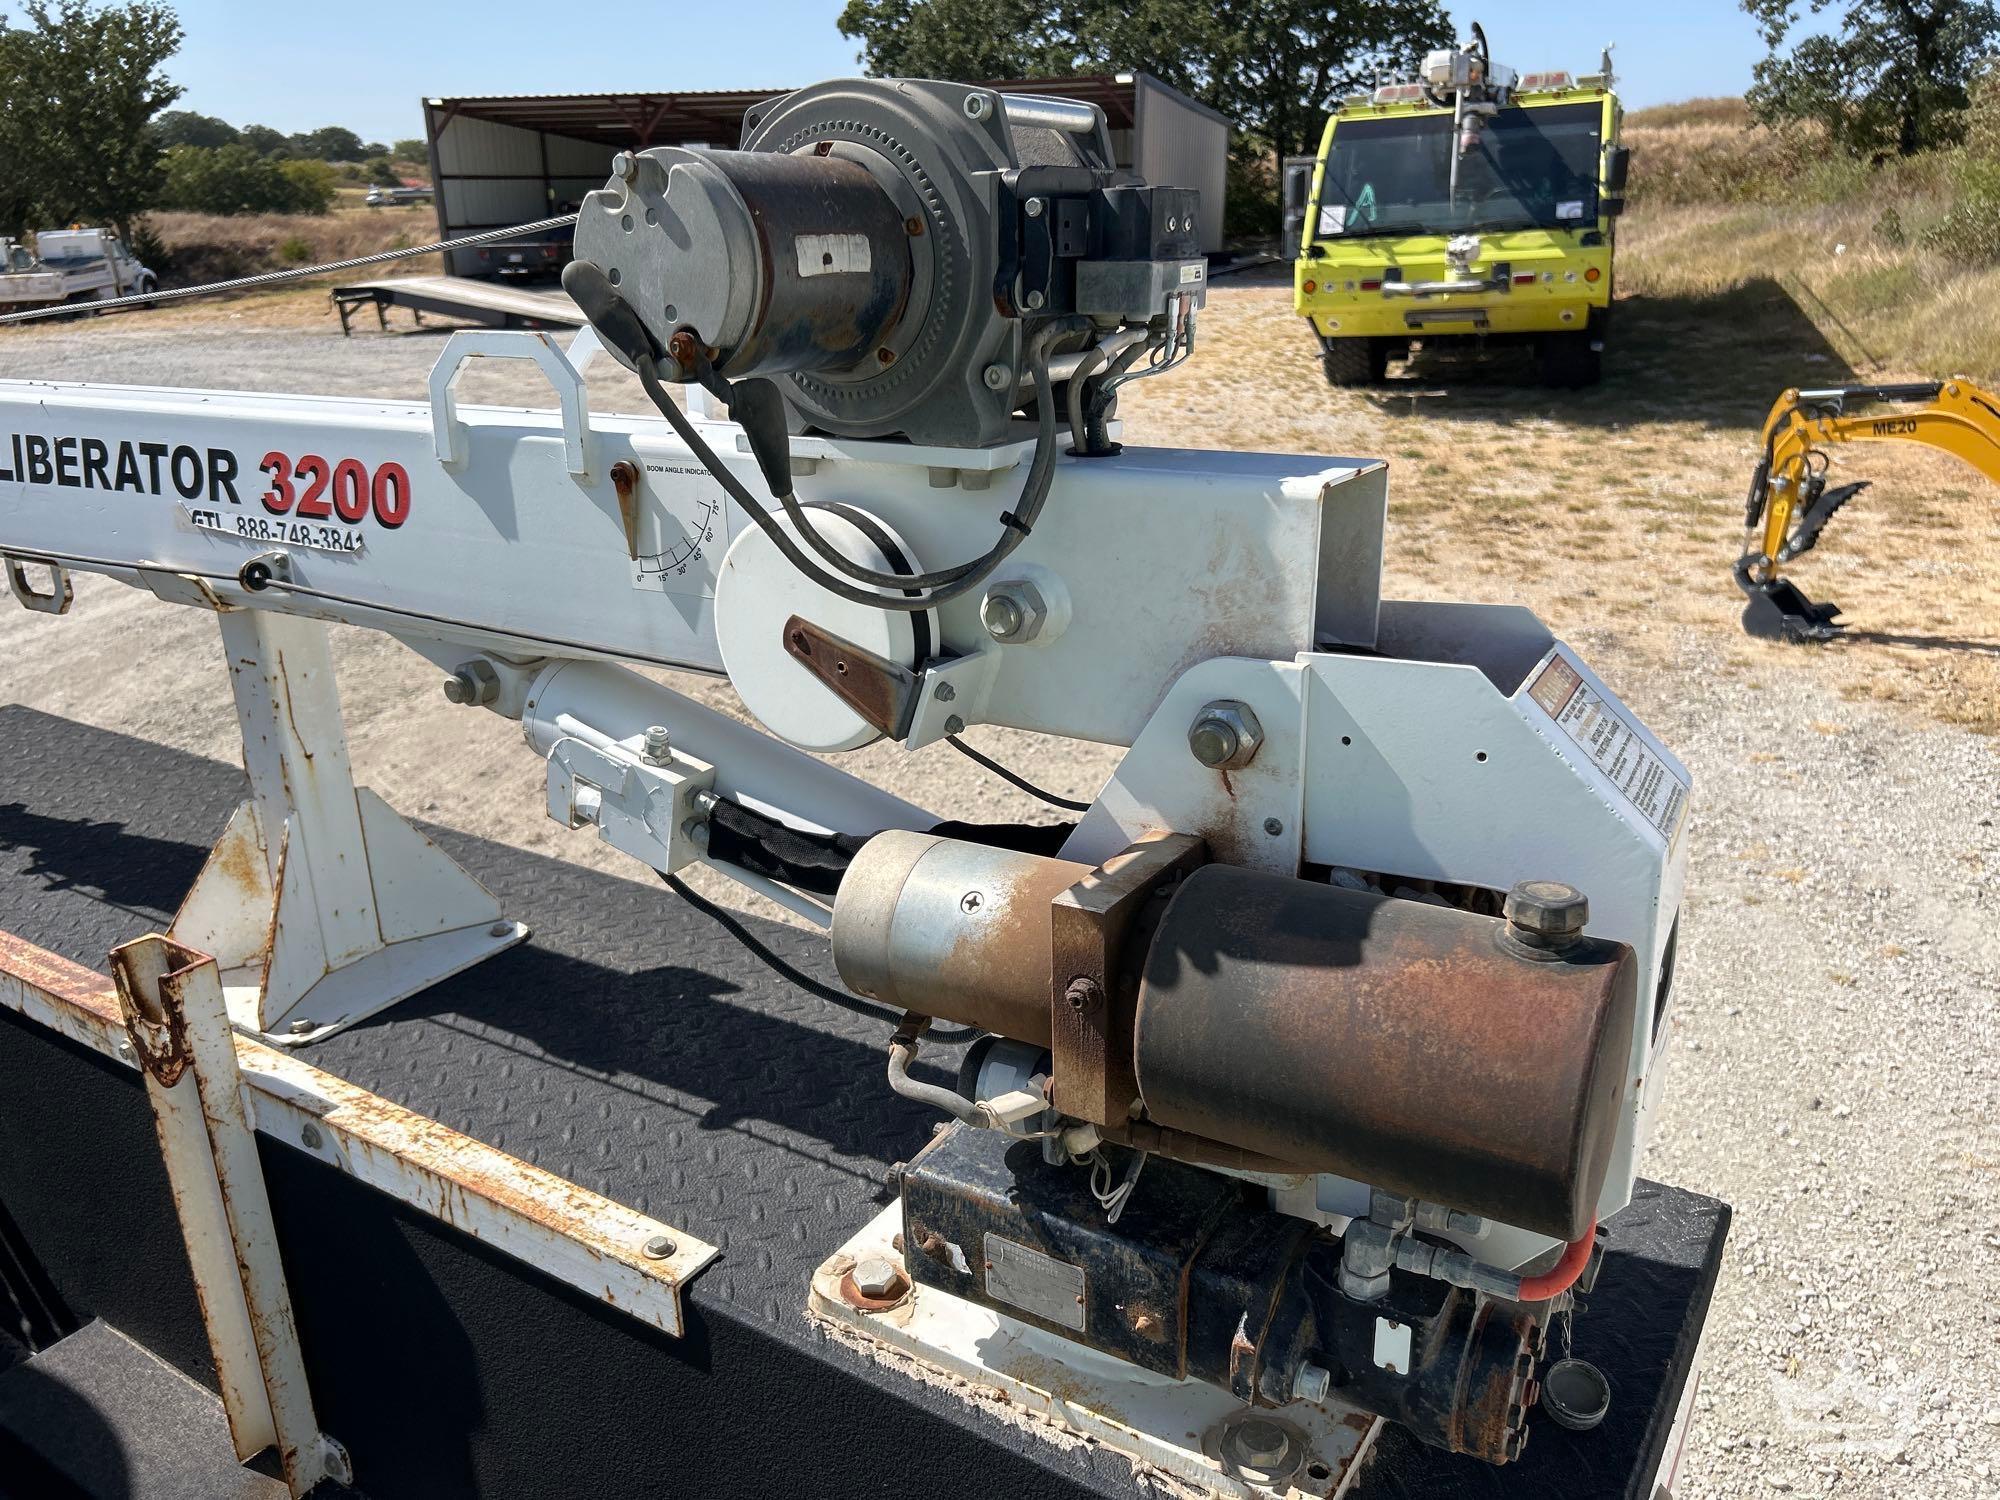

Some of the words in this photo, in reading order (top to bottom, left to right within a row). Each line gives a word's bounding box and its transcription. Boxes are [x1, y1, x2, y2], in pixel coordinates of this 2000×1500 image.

[1873, 419, 1917, 437] ME20
[646, 465, 664, 473] BOOM
[665, 466, 684, 475] ANGLE
[684, 468, 713, 477] INDICATO
[259, 451, 412, 530] 3200
